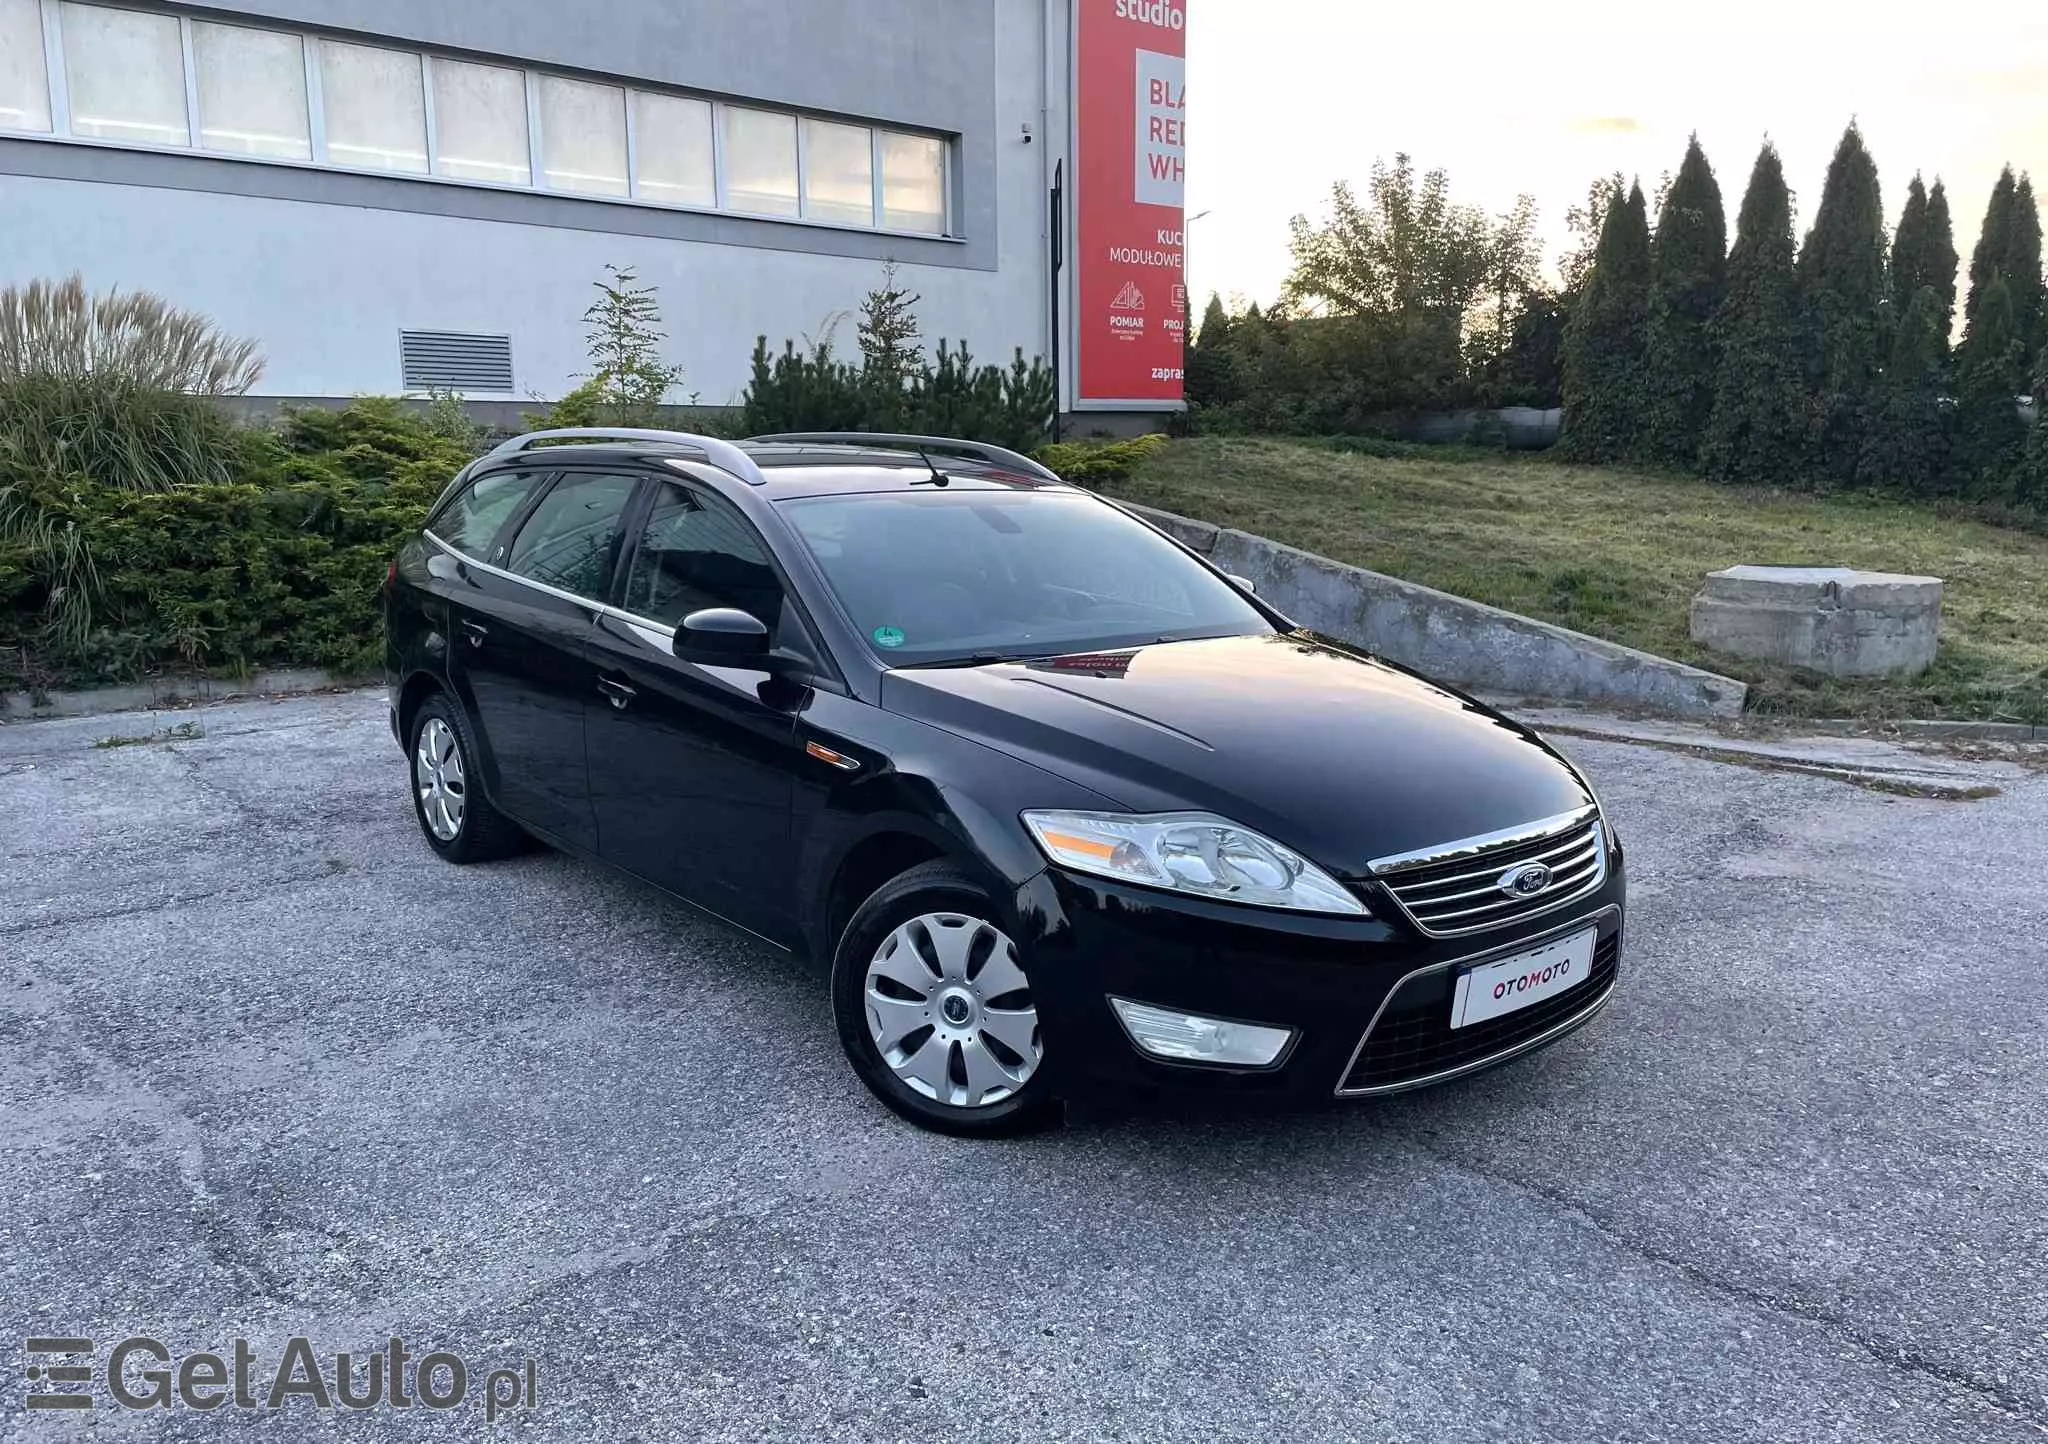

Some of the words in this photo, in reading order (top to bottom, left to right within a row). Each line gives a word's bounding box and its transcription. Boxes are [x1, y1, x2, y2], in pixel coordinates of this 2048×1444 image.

[1115, 0, 1184, 30] studio
[1157, 229, 1184, 246] KUC
[1110, 247, 1182, 268] MODUŁOWE
[1110, 315, 1144, 327] POMIAR
[1523, 870, 1543, 890] Ford
[1493, 959, 1570, 999] OTOMOTO
